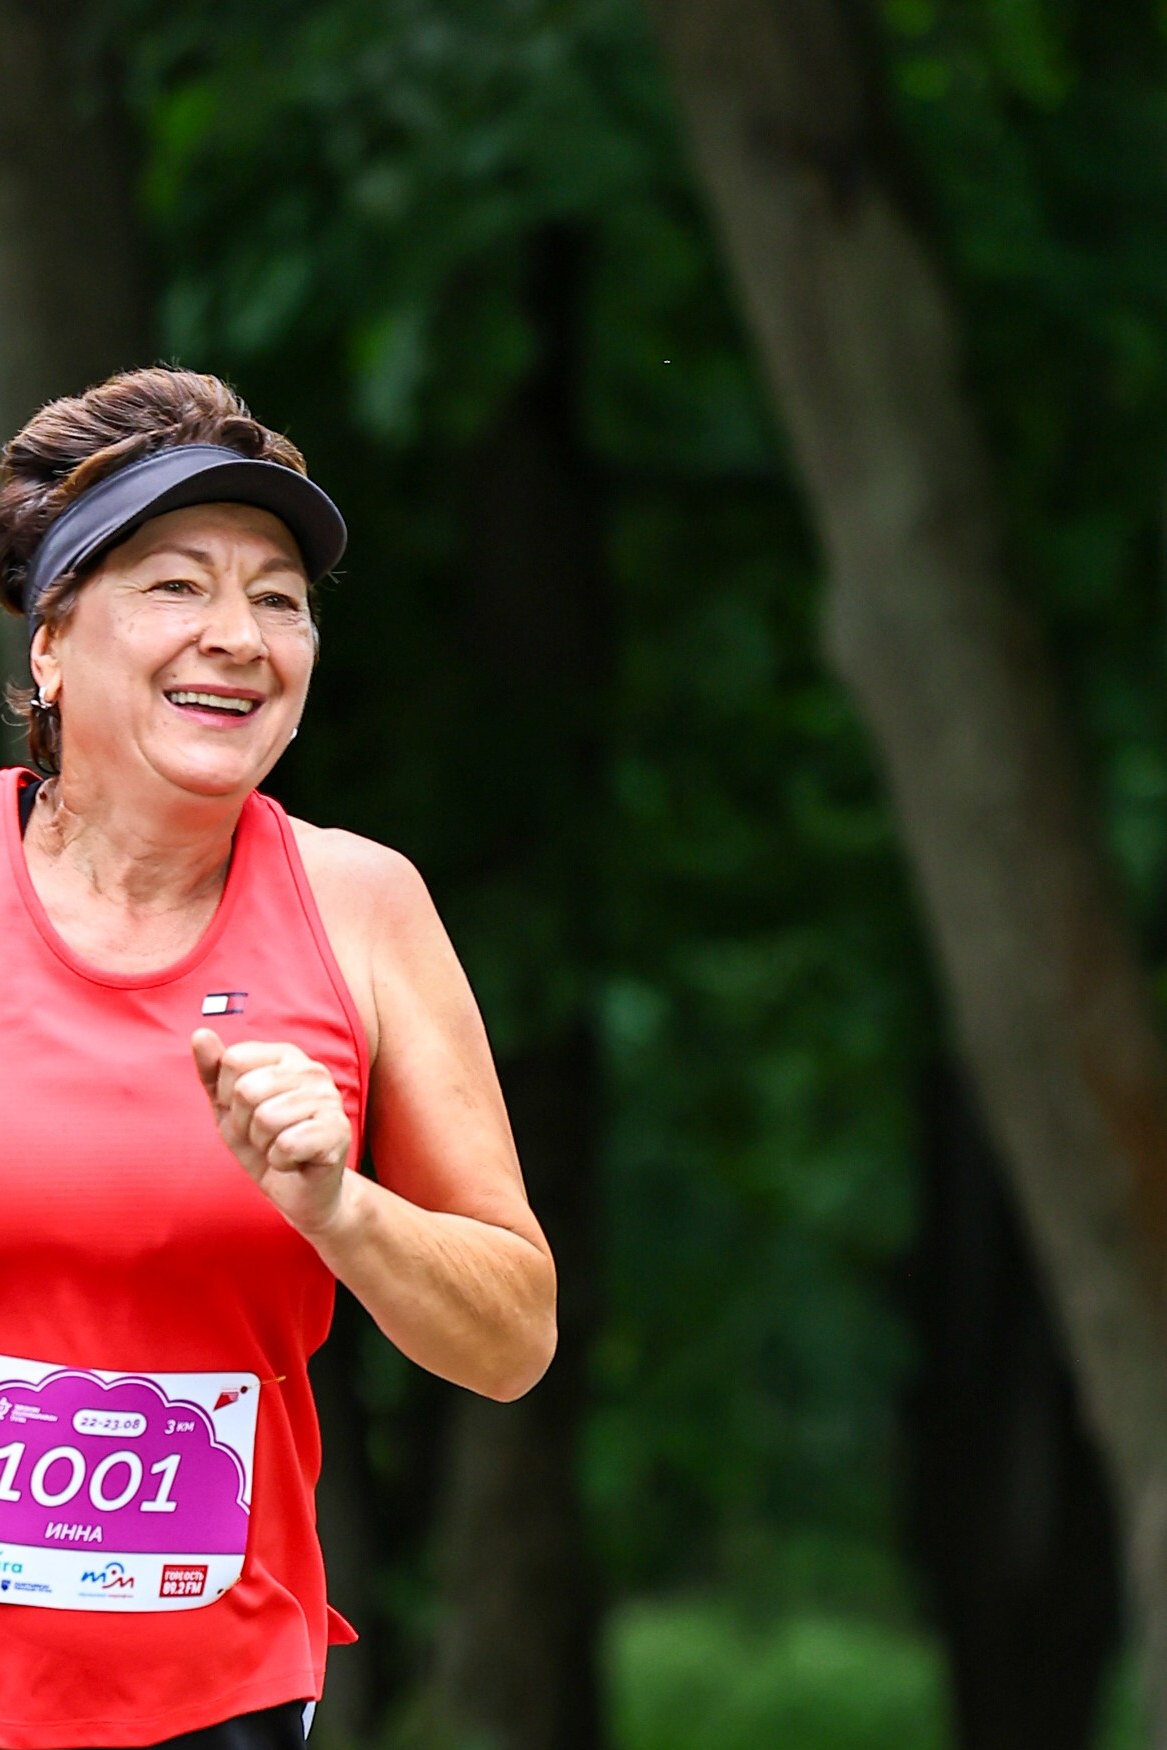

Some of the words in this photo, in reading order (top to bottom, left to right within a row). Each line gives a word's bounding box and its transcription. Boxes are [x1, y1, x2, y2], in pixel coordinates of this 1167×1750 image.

[80, 1417, 141, 1431] 22-23.08
[164, 1419, 177, 1435] 3
[44, 1521, 103, 1543] ИННА
